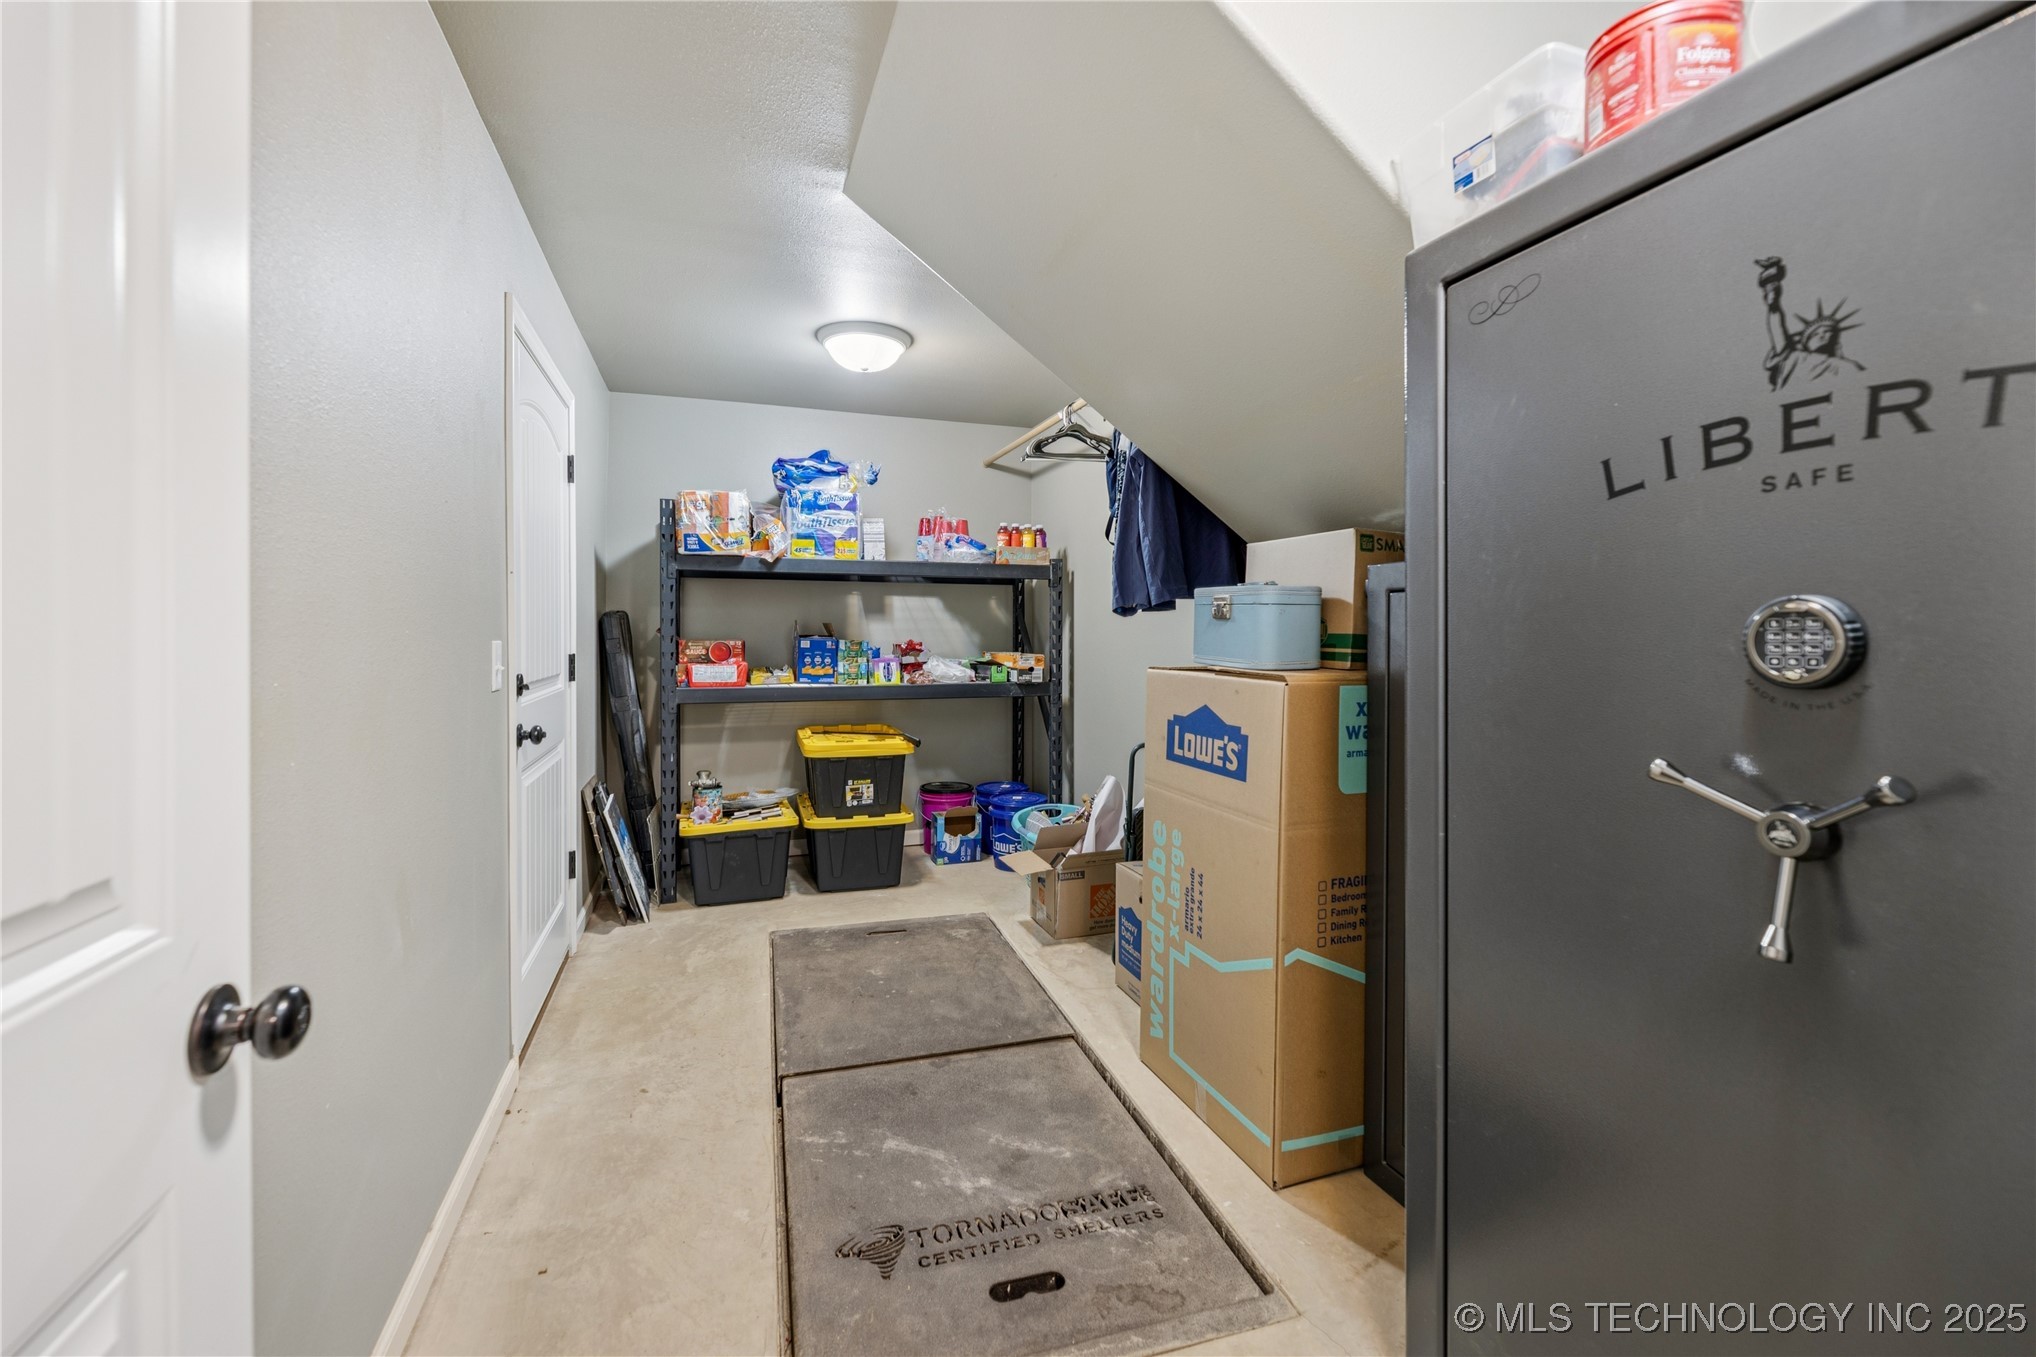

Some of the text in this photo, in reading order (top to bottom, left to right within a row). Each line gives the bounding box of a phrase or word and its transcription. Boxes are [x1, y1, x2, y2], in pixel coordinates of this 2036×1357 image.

[1676, 45, 1731, 64] Folgers
[1600, 362, 2036, 500] LIBERT
[1760, 463, 1855, 493] SAFE
[1376, 537, 1406, 552] SMA
[1173, 725, 1240, 772] LOWE'S
[1346, 750, 1368, 758] arma
[1060, 871, 1083, 880] SMALL
[1167, 828, 1185, 943] x-large
[1196, 899, 1203, 913] 24
[1331, 906, 1359, 917] Family
[1121, 915, 1138, 937] Heavy
[1146, 819, 1167, 1040] wardrobe
[1196, 925, 1203, 940] 24
[1330, 920, 1357, 931] Dining
[1121, 926, 1134, 944] Duty
[1330, 934, 1363, 946] Kitchen
[918, 1206, 1166, 1269] CERTIFIED SHELTERS
